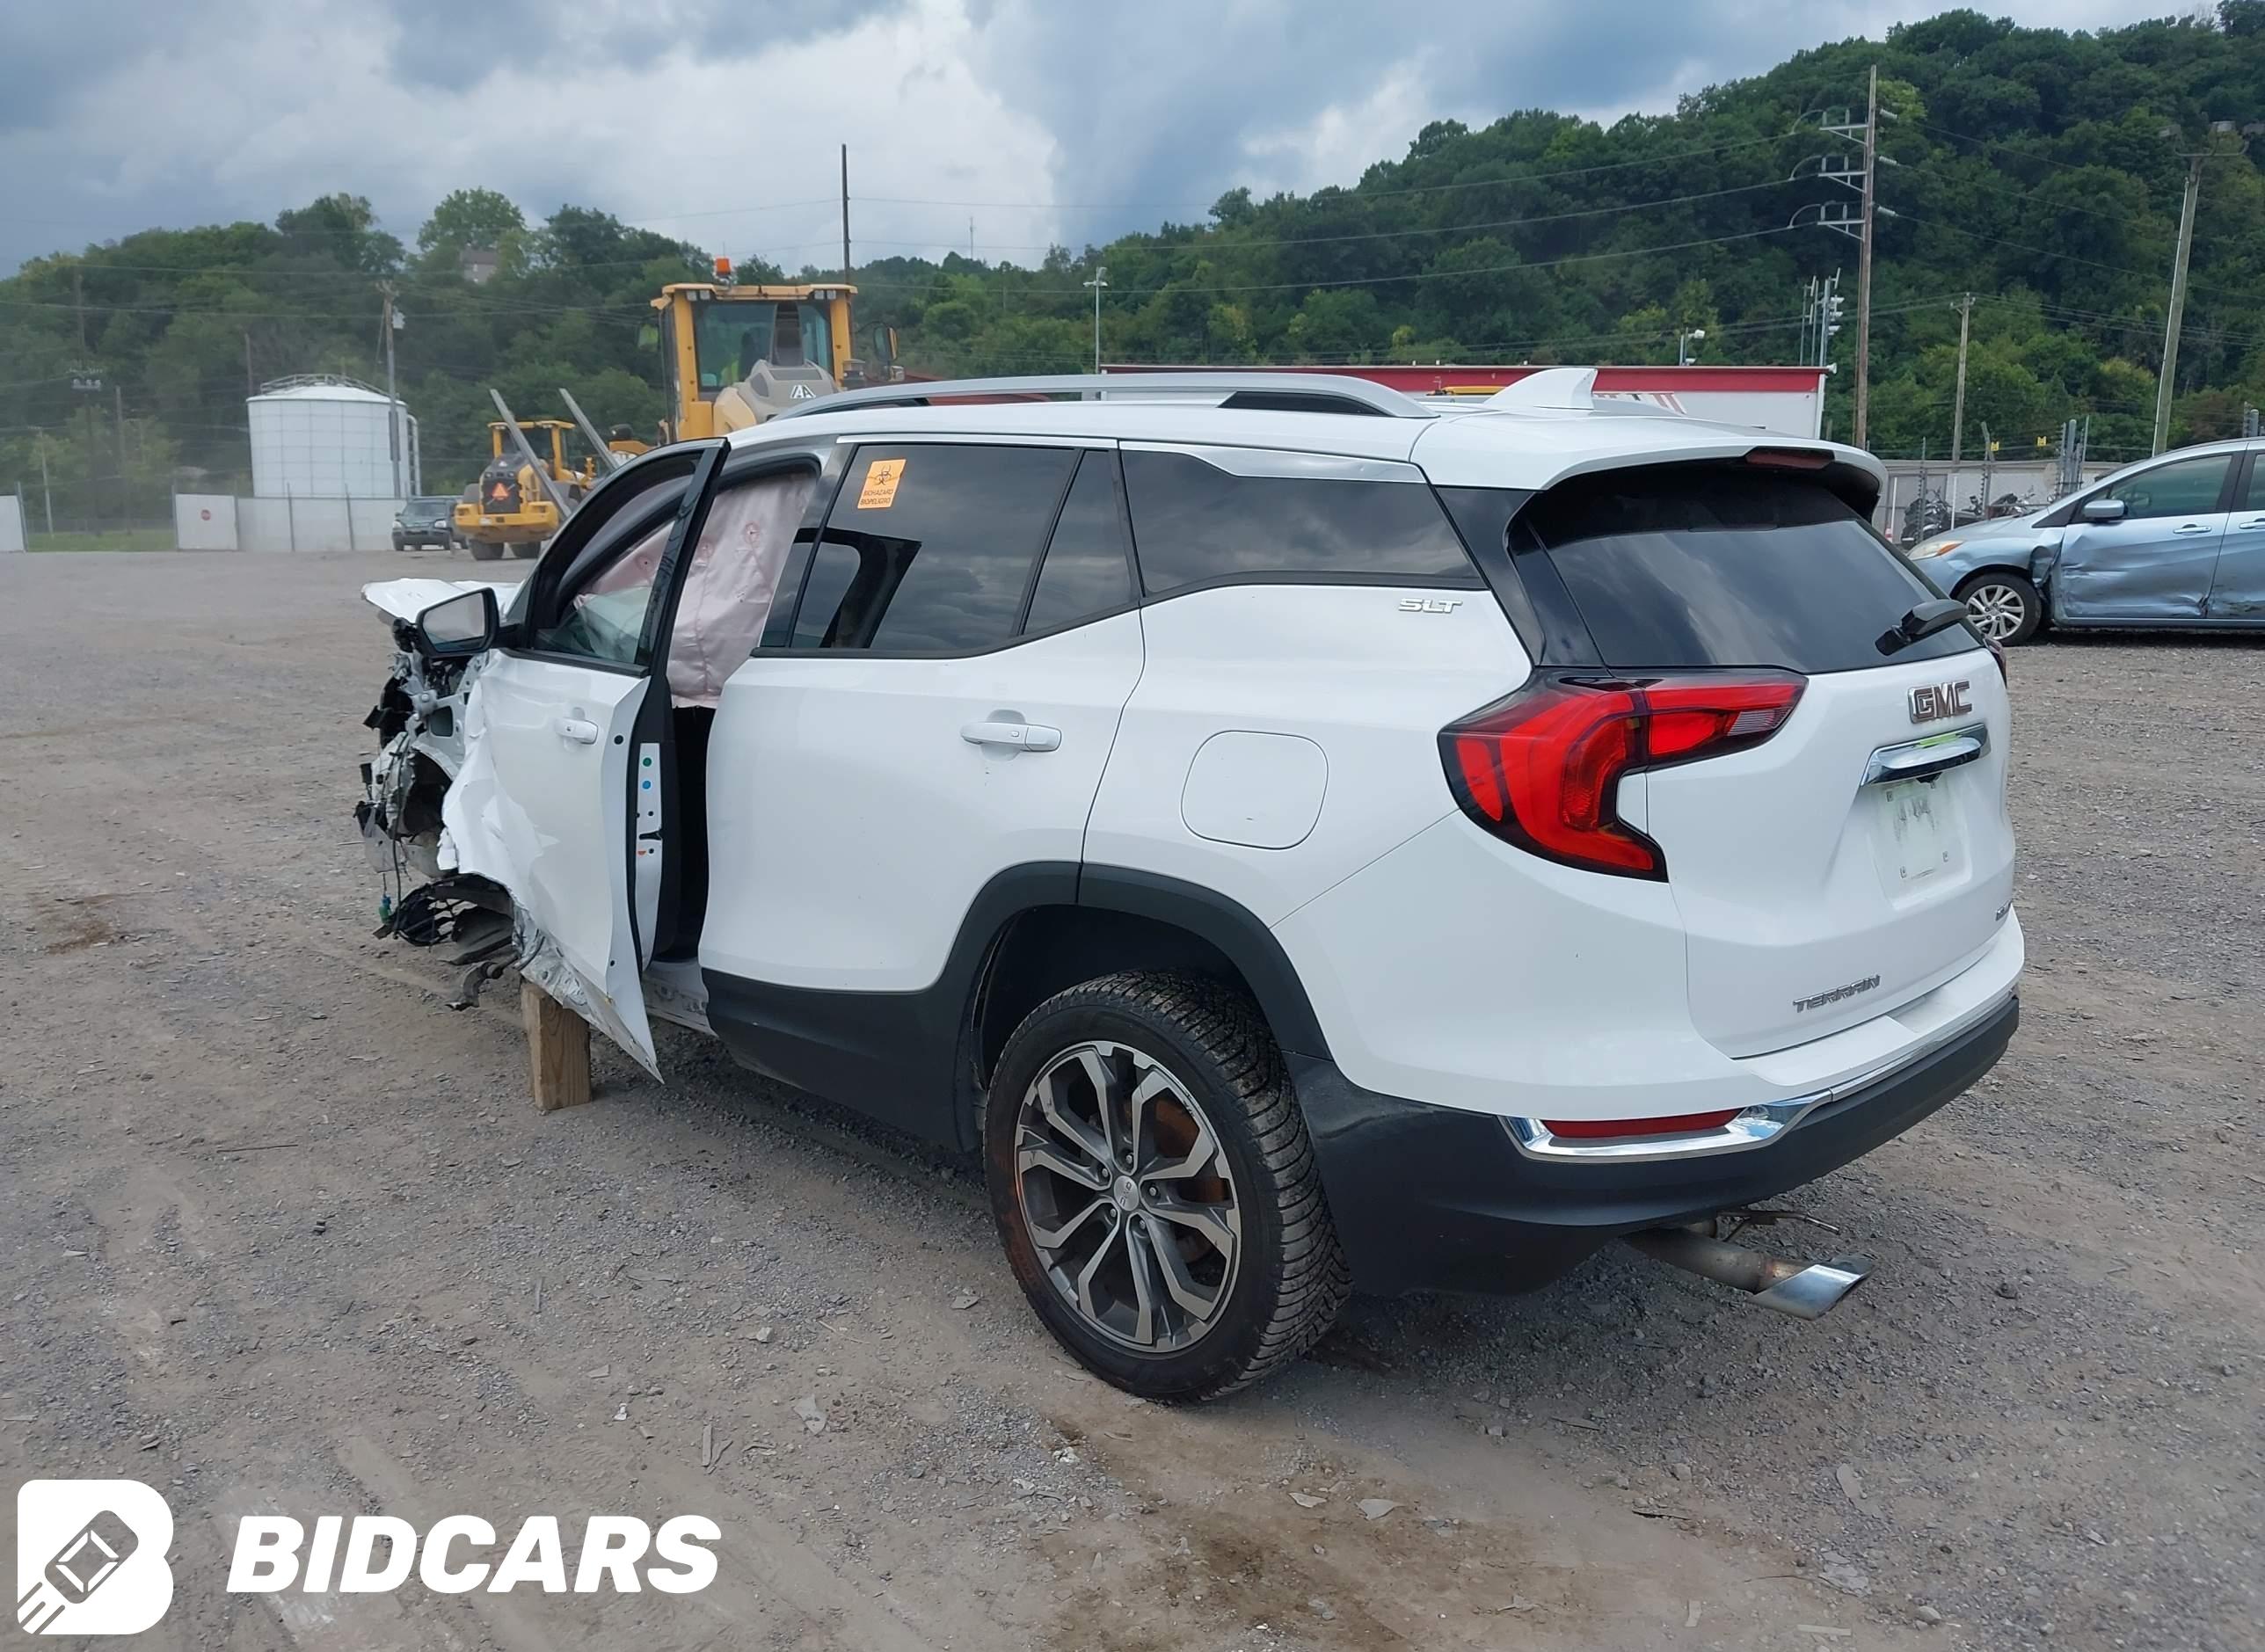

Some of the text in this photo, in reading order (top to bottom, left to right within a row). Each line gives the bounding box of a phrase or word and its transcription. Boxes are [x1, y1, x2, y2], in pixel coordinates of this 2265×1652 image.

[1398, 598, 1463, 615] SLT
[1907, 680, 1973, 724] GMC
[1792, 973, 1881, 1013] TERRAIN
